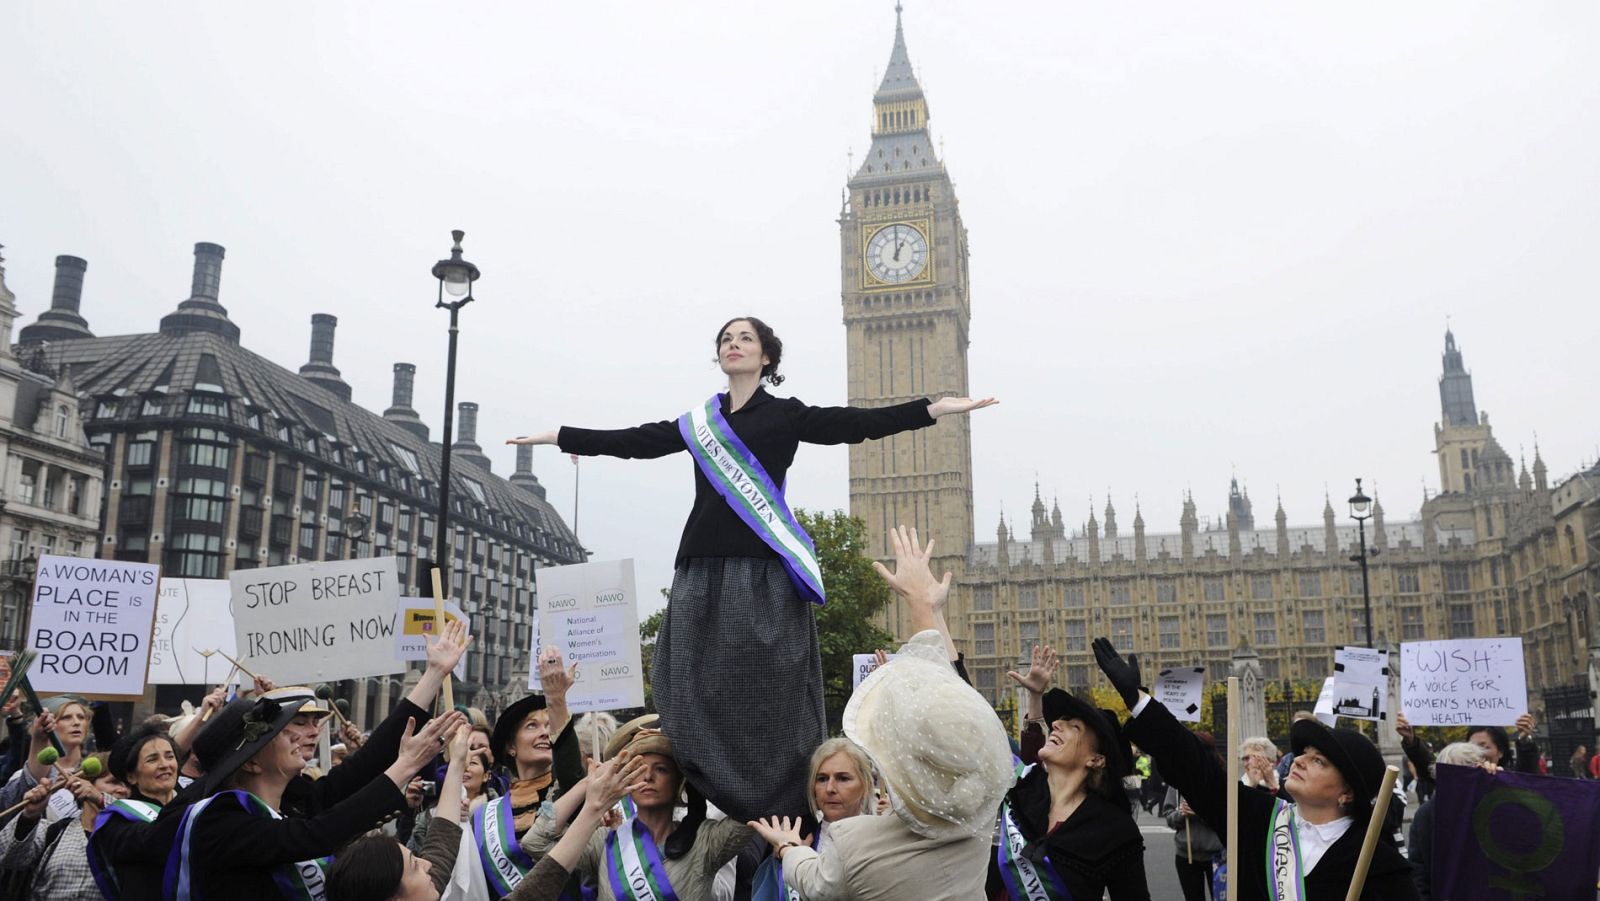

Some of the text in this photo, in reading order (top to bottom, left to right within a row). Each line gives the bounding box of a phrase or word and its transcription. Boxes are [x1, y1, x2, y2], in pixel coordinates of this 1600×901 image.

[720, 455, 733, 472] FOR
[731, 468, 777, 524] WOMEN
[39, 564, 154, 585] A WOMAN'S
[36, 585, 142, 608] PLACE IS
[160, 588, 179, 597] UTE
[245, 571, 386, 609] STOP BREAST
[548, 599, 576, 608] NAWO
[596, 593, 625, 603] NAWO
[64, 610, 118, 624] IN THE
[567, 616, 597, 625] National
[246, 613, 397, 658] IRONING NOW
[567, 629, 595, 637] Alliance
[35, 629, 139, 652] BOARD
[568, 640, 602, 649] Women's
[568, 650, 617, 661] Organisations
[1417, 649, 1491, 673] WISH
[40, 654, 129, 676] ROOM
[600, 666, 629, 676] NAWO
[1408, 680, 1500, 693] A VOICE FOR
[1404, 697, 1515, 710] WOMEN'S MENTAL
[1431, 712, 1472, 725] HEALTH
[1017, 857, 1032, 877] FOR
